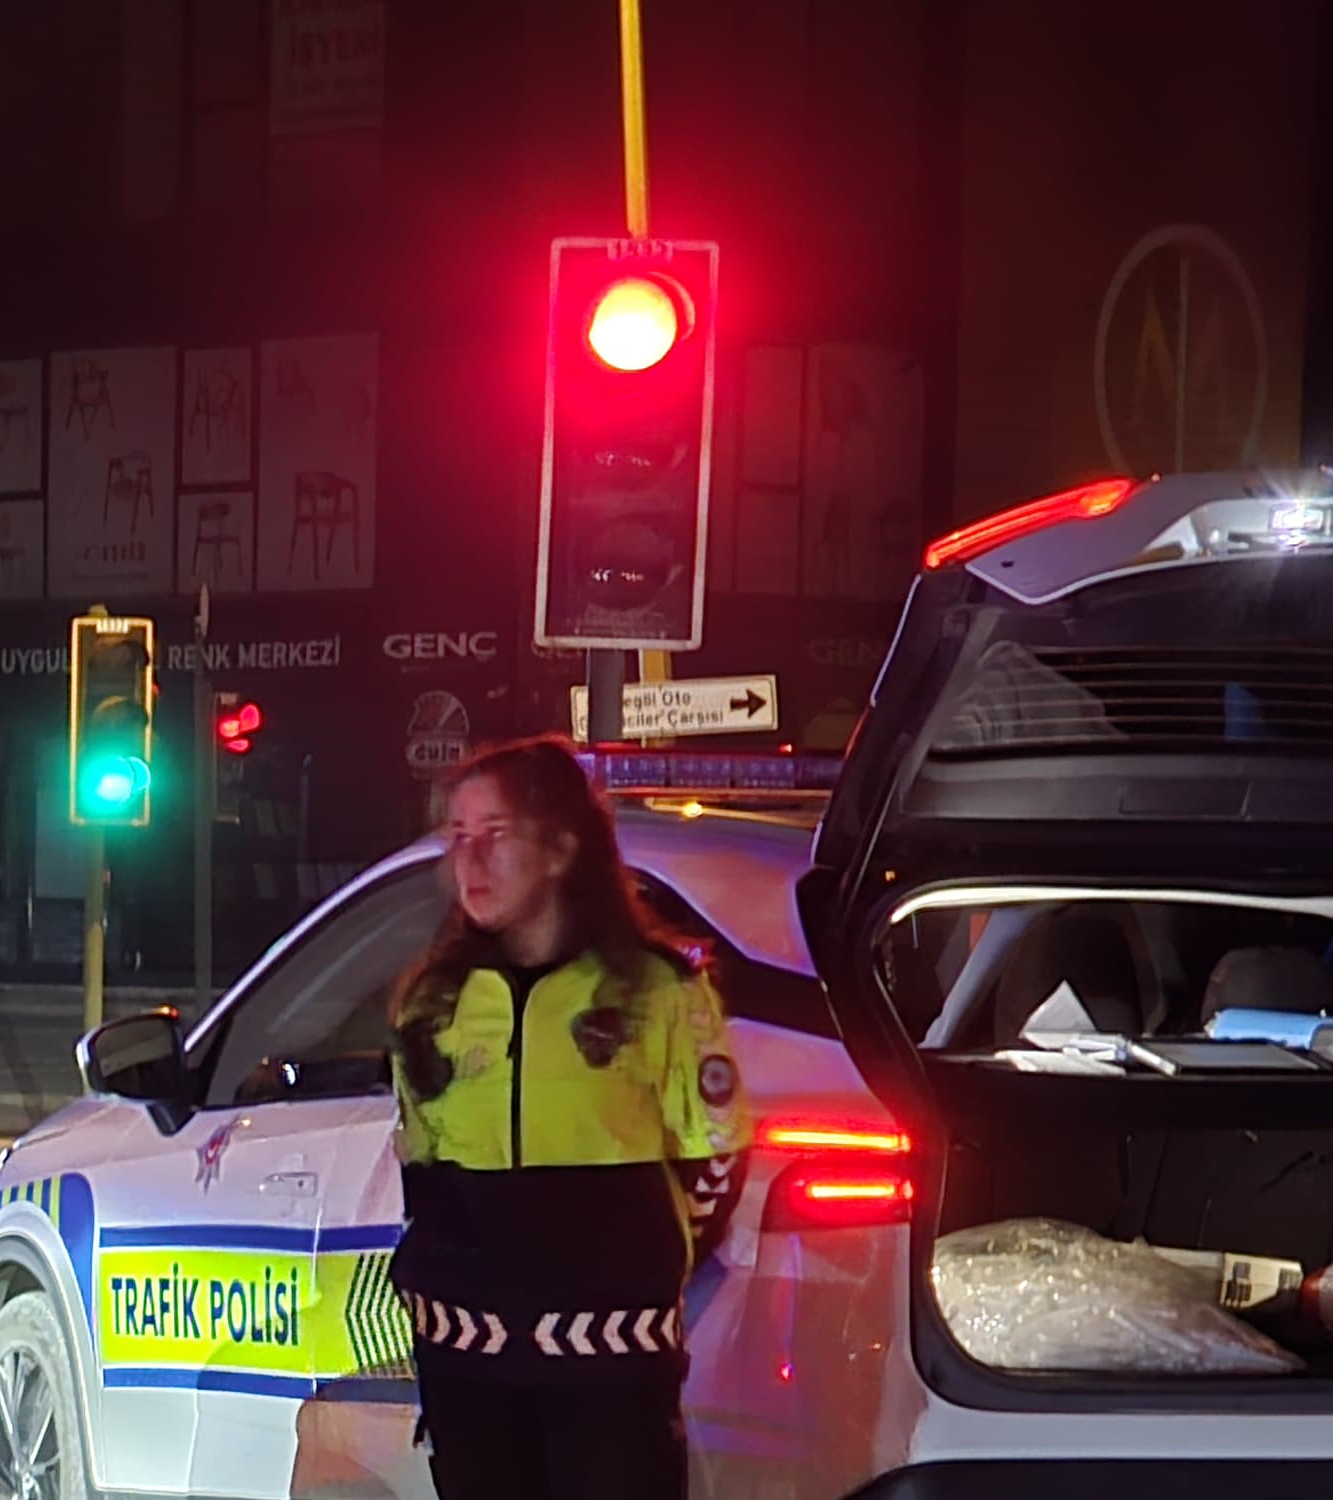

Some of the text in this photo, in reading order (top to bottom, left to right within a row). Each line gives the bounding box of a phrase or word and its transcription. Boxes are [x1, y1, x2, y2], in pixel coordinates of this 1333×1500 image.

[237, 632, 341, 669] MERKEZİ
[383, 631, 498, 662] GENÇ
[807, 638, 888, 667] GEN
[662, 688, 692, 707] Oto
[110, 1262, 300, 1347] TRAFİK POLİSİ
